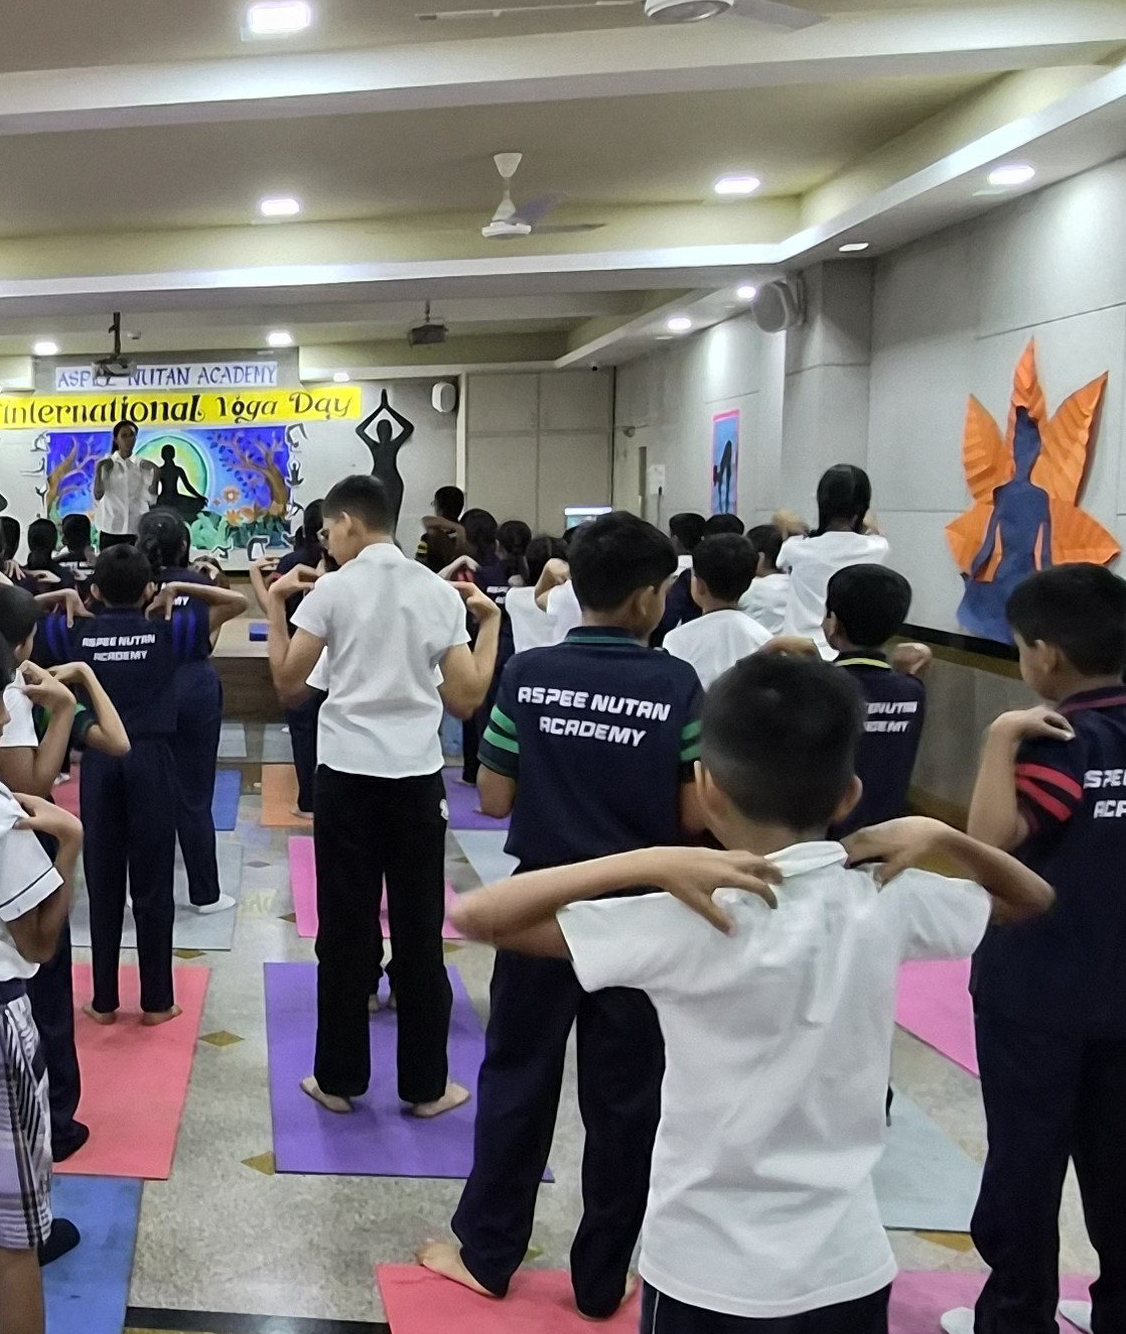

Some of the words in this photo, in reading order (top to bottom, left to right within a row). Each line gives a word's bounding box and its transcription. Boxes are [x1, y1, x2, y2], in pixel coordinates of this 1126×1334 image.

[128, 367, 190, 386] NUTAN
[197, 365, 276, 385] ACADEMY
[217, 393, 278, 424] Yoga
[289, 391, 353, 421] Day
[118, 633, 156, 646] NUTAN
[93, 650, 148, 662] ACADEMY
[517, 686, 589, 709] ASPEE
[590, 693, 672, 722] NUTAN
[539, 715, 648, 748] ACADEMY
